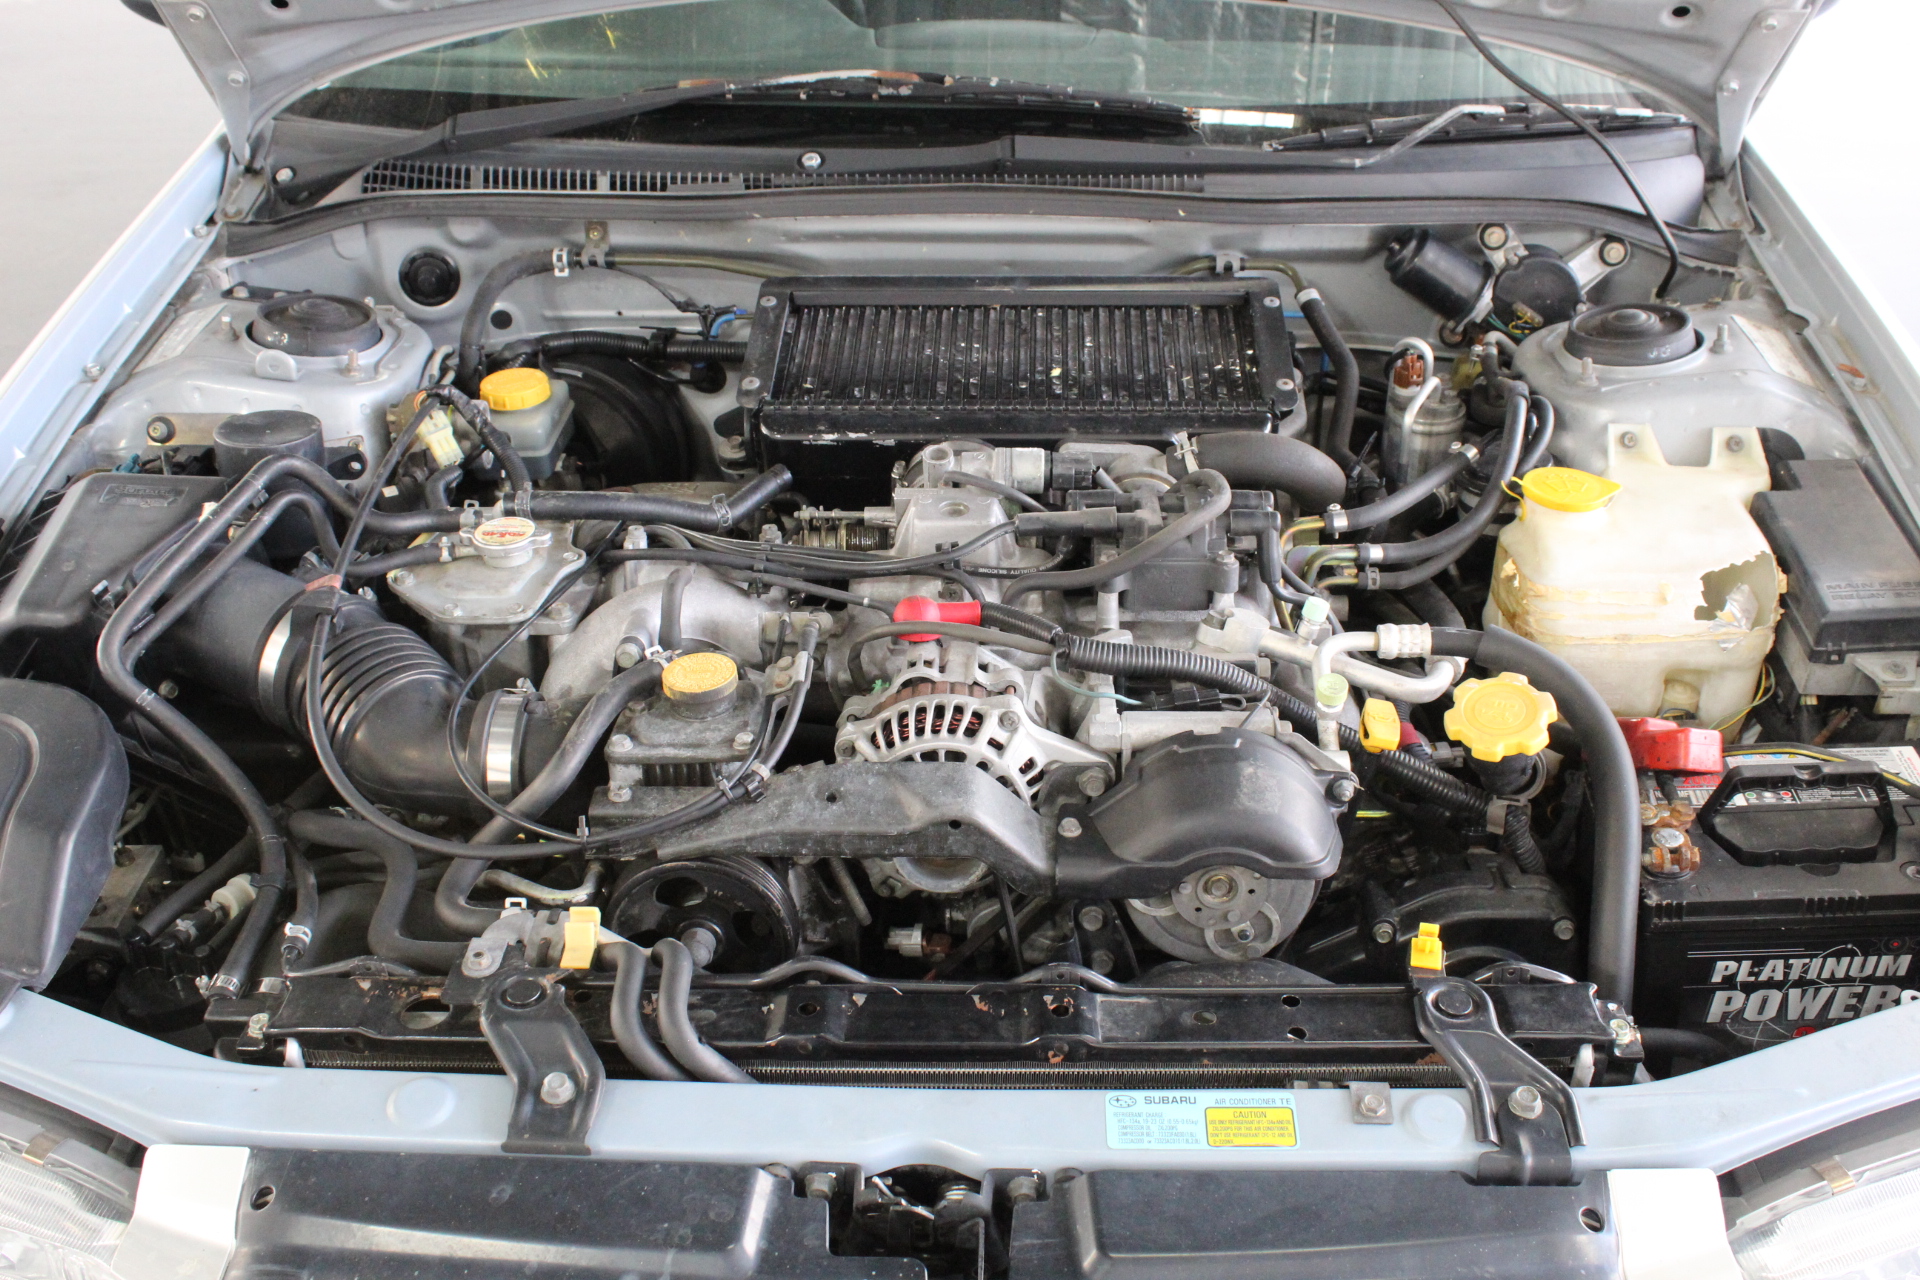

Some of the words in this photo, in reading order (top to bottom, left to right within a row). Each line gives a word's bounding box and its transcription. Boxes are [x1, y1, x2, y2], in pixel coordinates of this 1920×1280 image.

[978, 567, 1007, 575] SILICONE
[1831, 592, 1886, 600] RELAY
[1893, 591, 1920, 599] BO
[1710, 955, 1913, 983] PLATINUM
[1144, 1096, 1196, 1104] SUBARU
